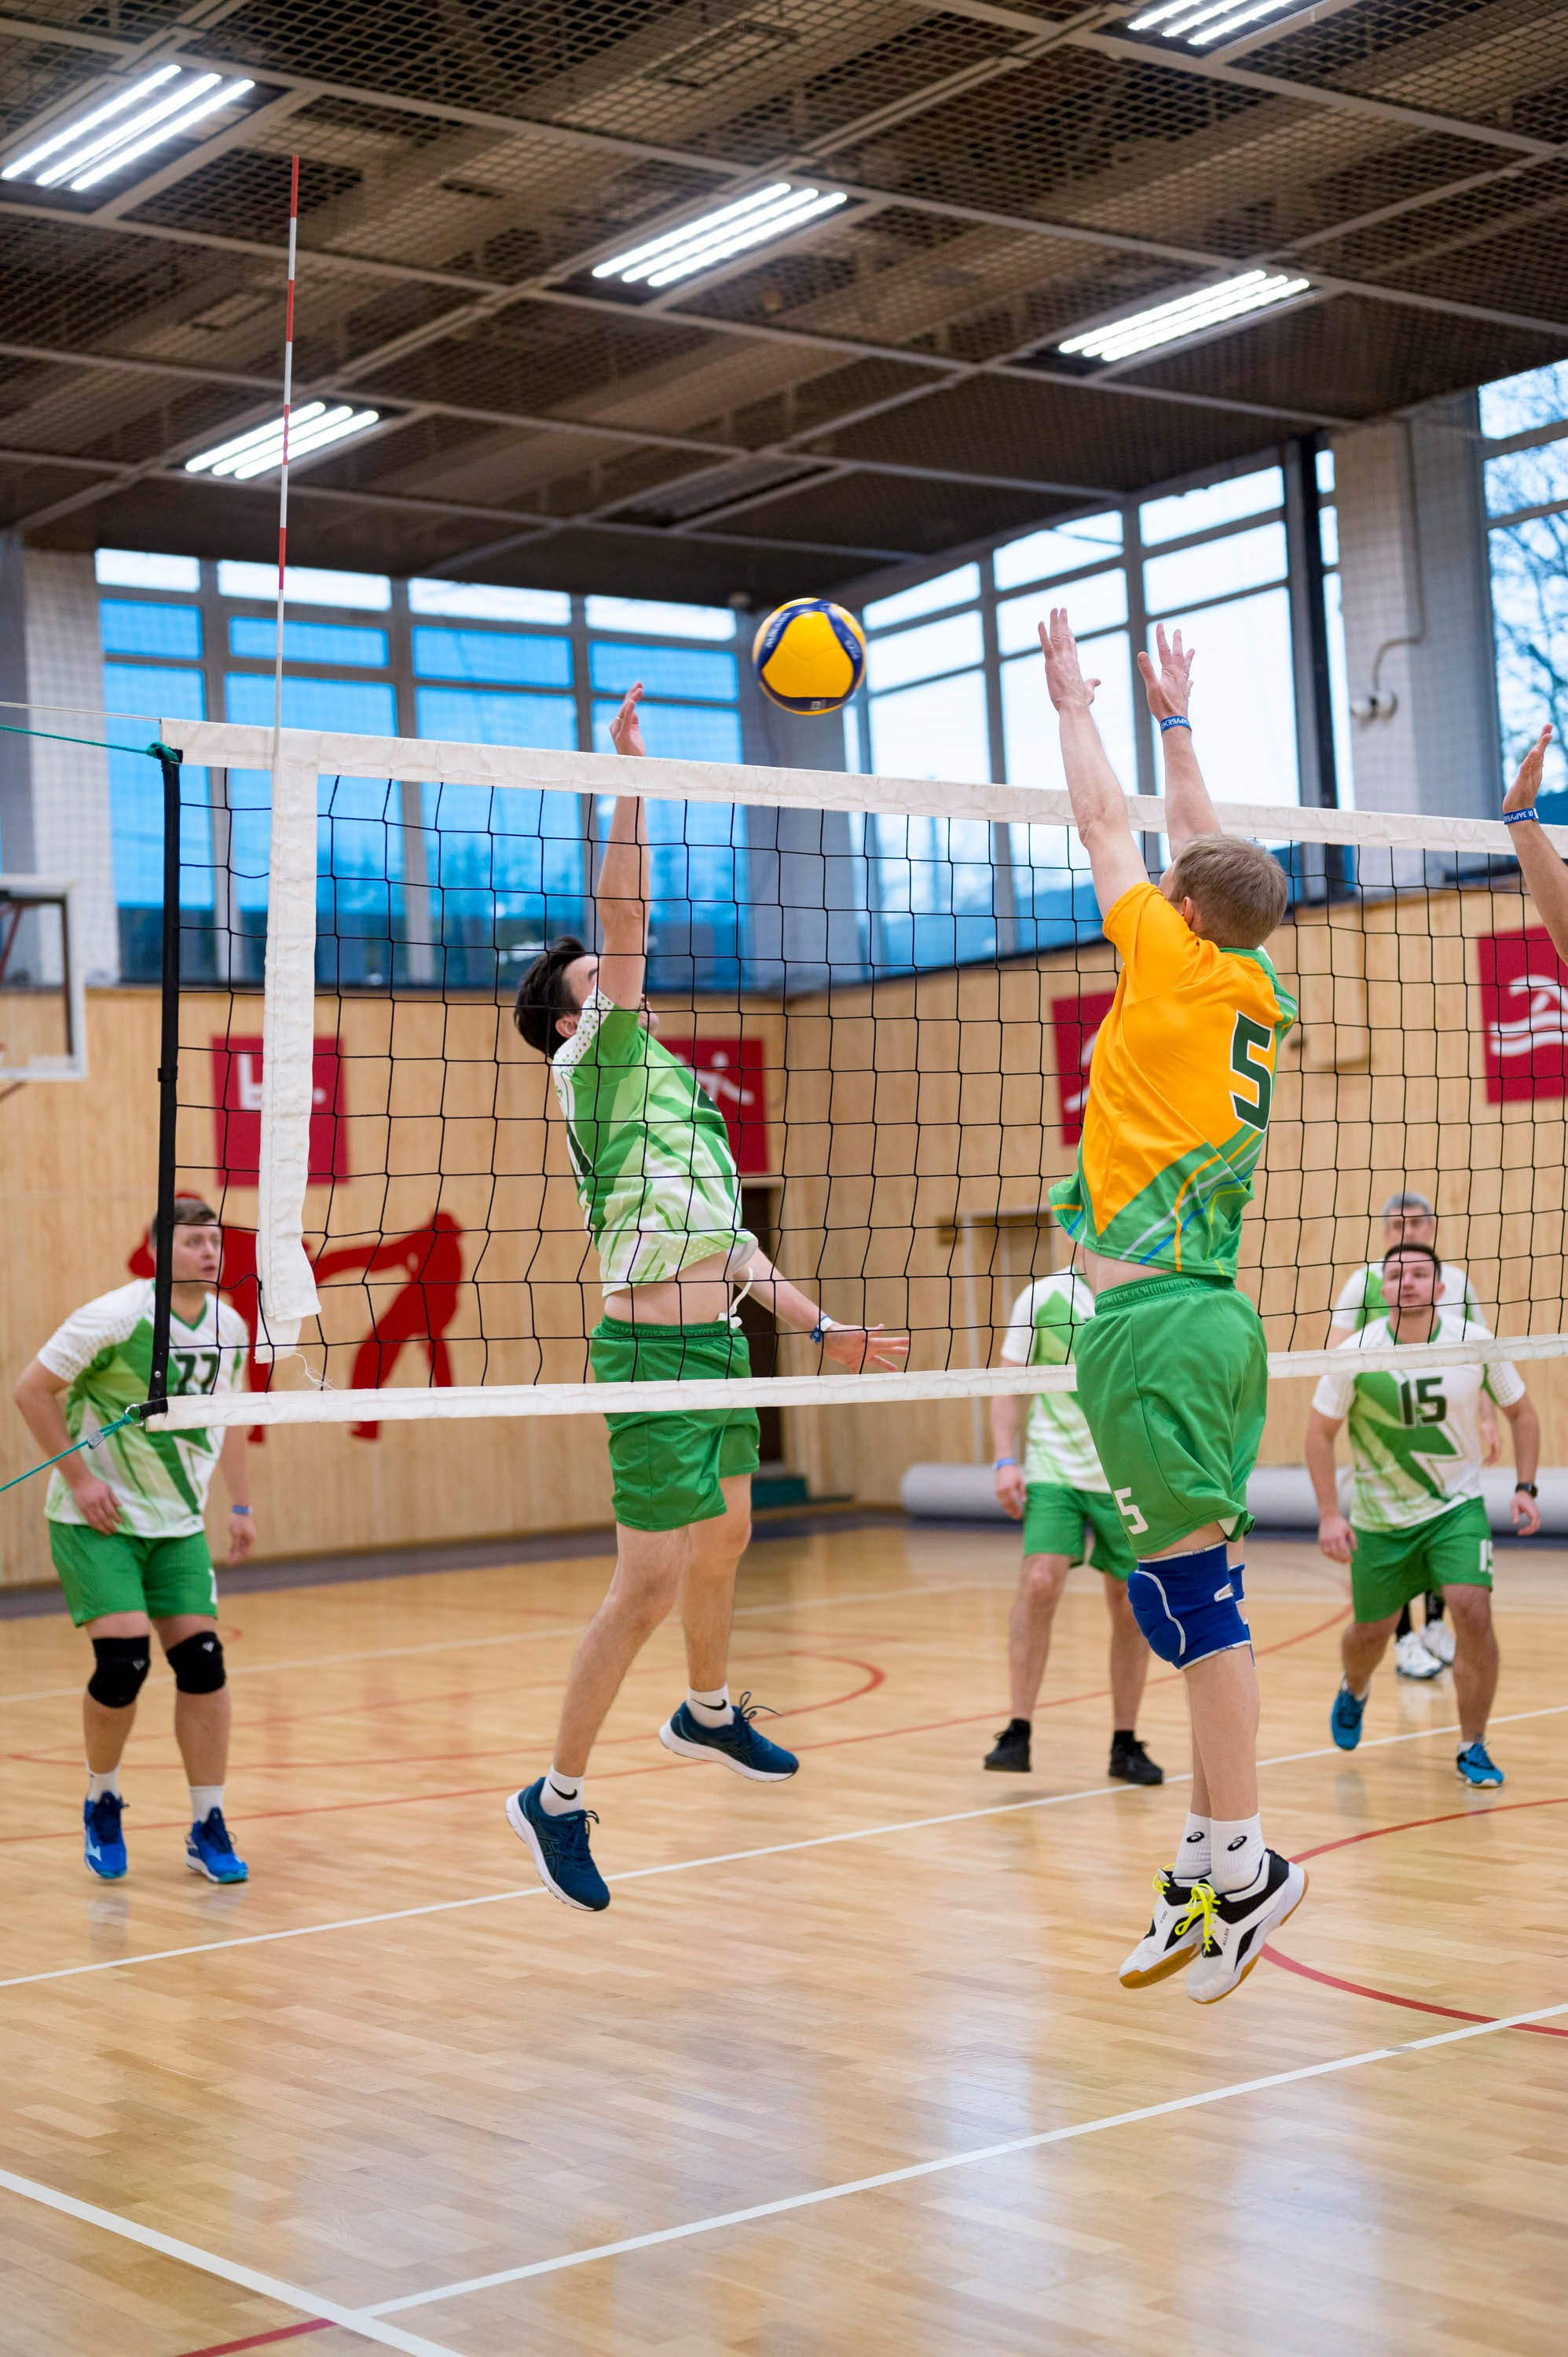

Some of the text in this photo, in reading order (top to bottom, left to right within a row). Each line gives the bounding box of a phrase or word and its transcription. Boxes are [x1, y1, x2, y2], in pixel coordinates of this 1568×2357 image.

[1229, 1010, 1273, 1133] 5
[1401, 1376, 1447, 1425] 15
[1114, 1486, 1149, 1534] 5
